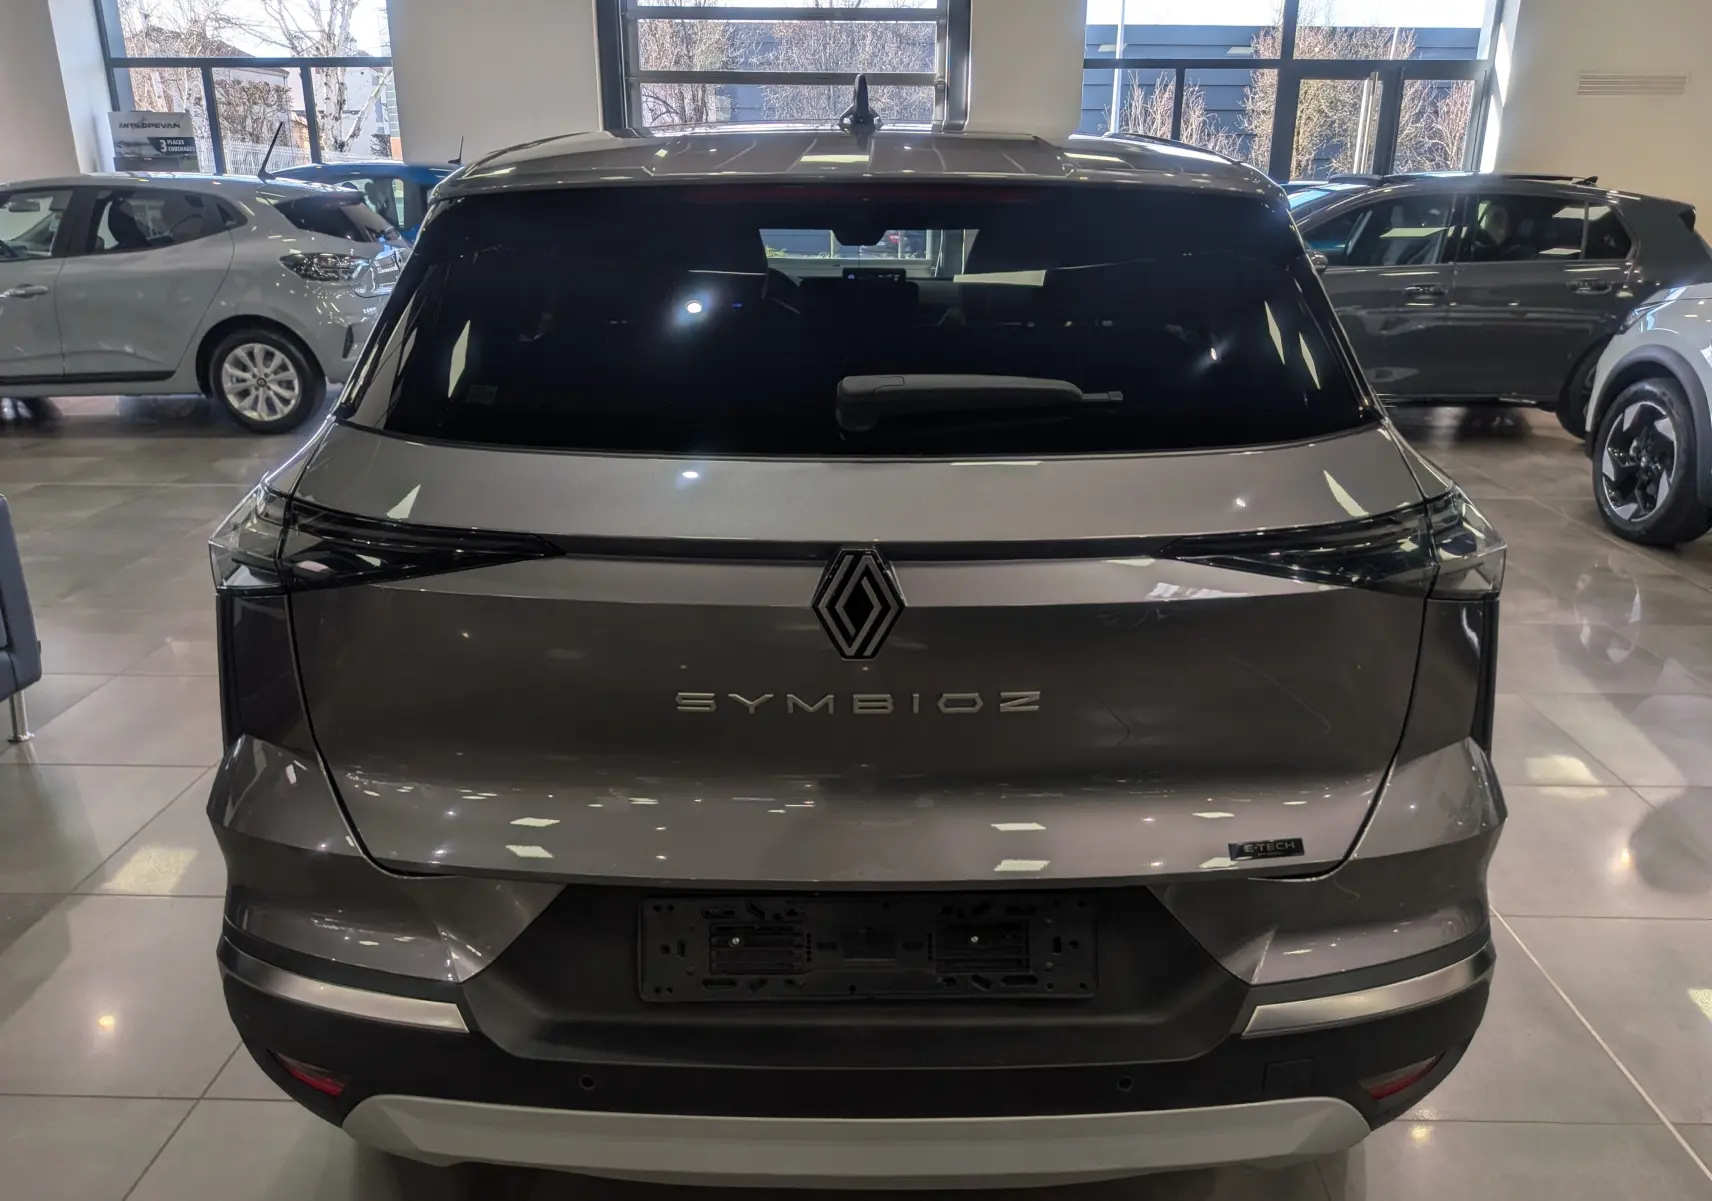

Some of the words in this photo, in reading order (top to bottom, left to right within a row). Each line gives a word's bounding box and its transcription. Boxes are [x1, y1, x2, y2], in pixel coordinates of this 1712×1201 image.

[160, 139, 167, 152] 3
[675, 691, 1041, 714] SYMBIOZ
[1244, 841, 1295, 853] E-TECH
